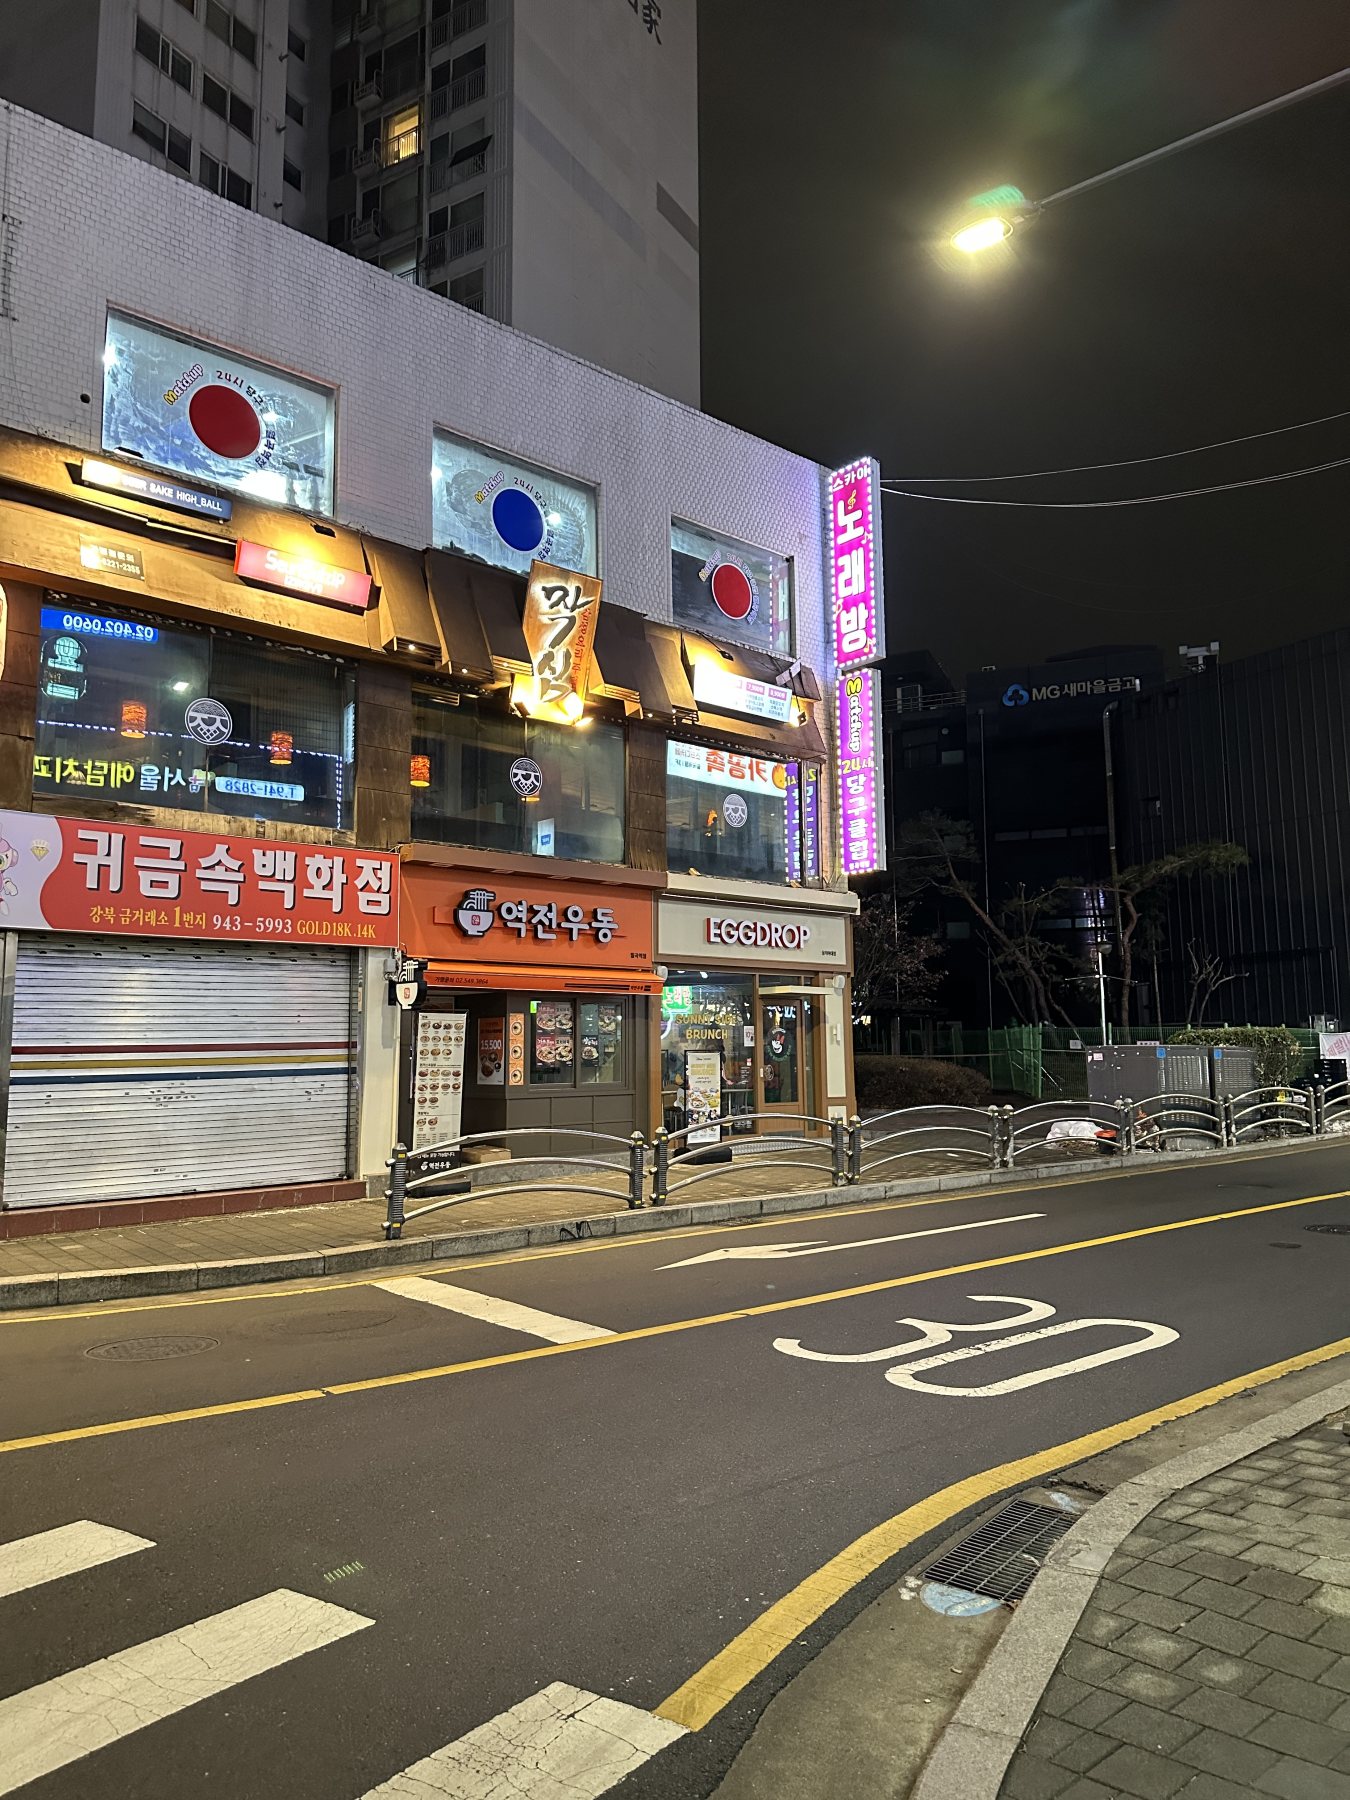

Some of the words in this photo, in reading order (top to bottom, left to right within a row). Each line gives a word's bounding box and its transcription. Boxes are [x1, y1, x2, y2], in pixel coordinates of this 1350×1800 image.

[163, 364, 204, 405] Matchup
[216, 370, 244, 388] 24시
[149, 482, 173, 498] SAKE
[474, 471, 504, 504] Matchup
[513, 477, 534, 493] 24시
[832, 465, 868, 492] 스카이
[836, 500, 870, 654] 노래방
[1012, 686, 1060, 701] MG
[1063, 677, 1136, 697] 새마을금고
[846, 676, 863, 753] Matchup
[842, 755, 874, 774] 24시
[846, 773, 869, 861] 당구클럽
[73, 829, 393, 915] 귀금속백화점
[89, 906, 116, 925] 강북
[119, 908, 170, 927] 금거래소
[173, 907, 207, 930] 1번지
[212, 915, 293, 935] 943-5993
[499, 900, 619, 943] 역전우동
[707, 917, 811, 949] EGGDROP
[676, 1014, 711, 1025] SUNNY
[686, 1029, 728, 1040] BRUNCH
[773, 1295, 1181, 1397] 30
